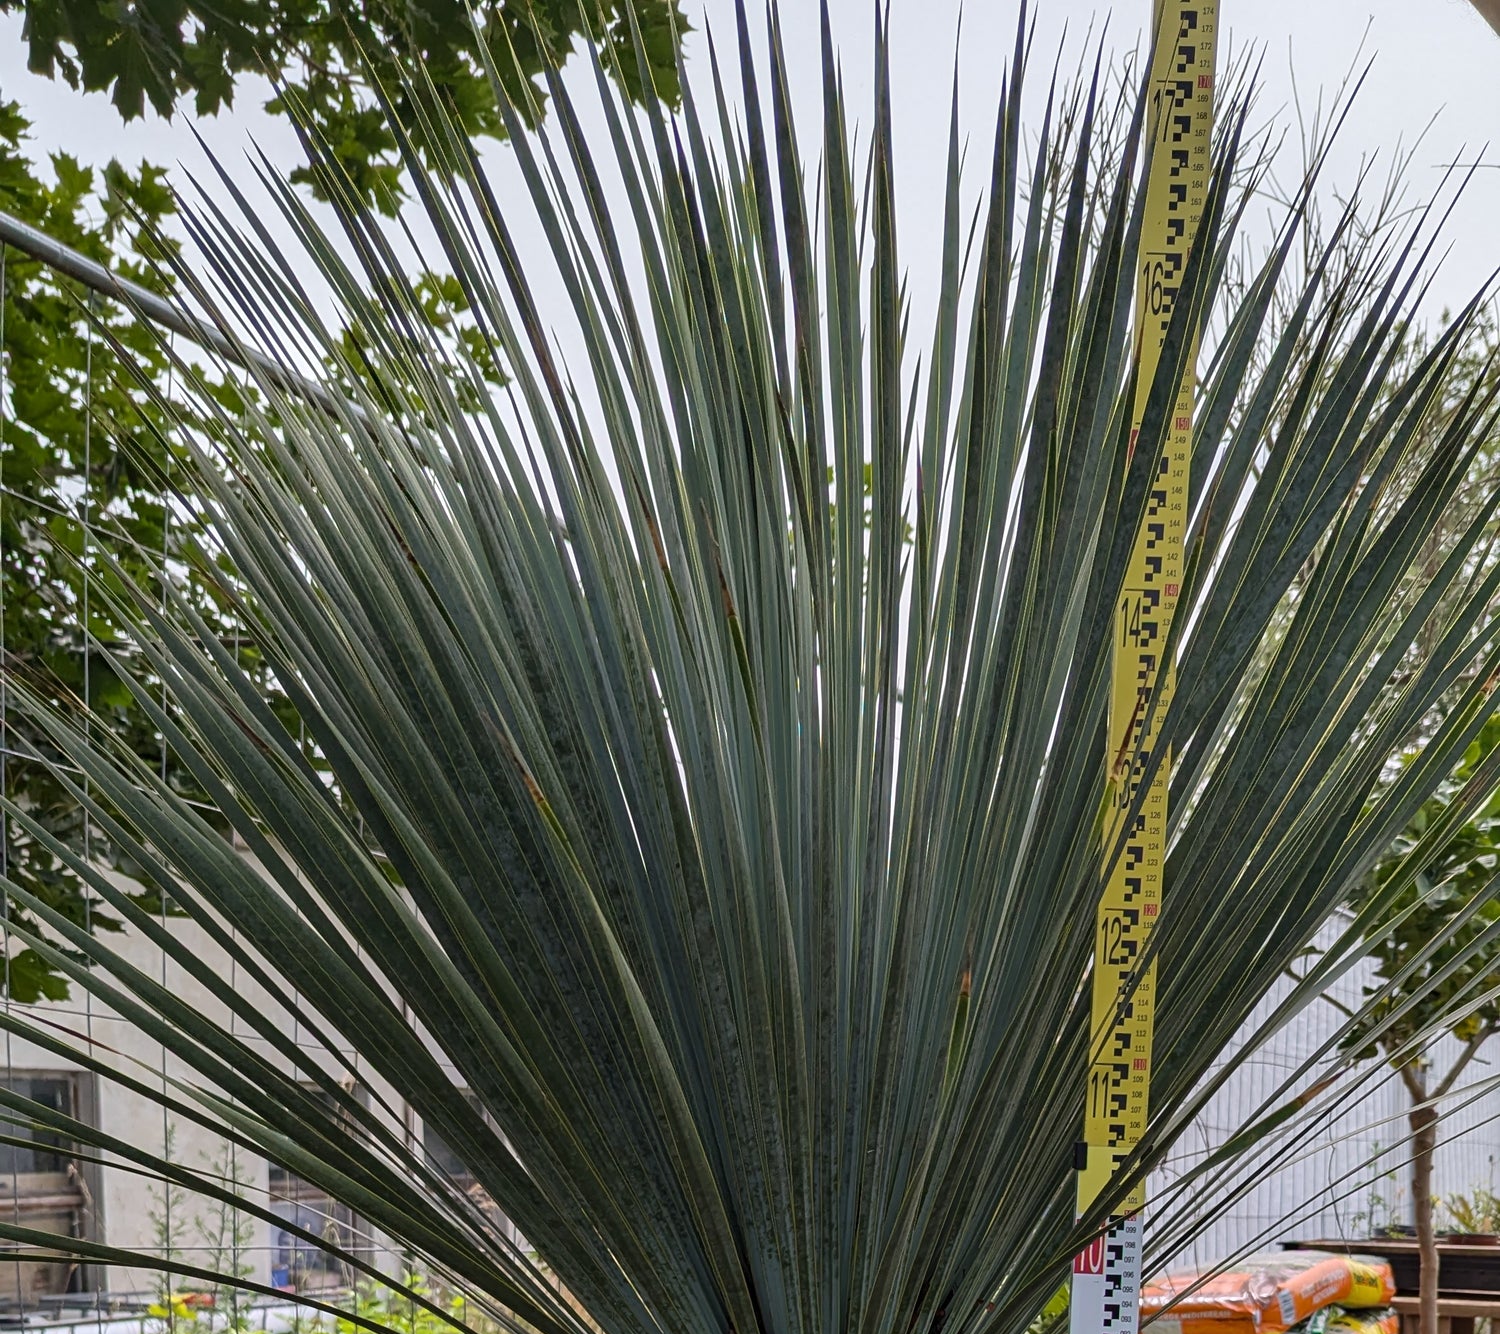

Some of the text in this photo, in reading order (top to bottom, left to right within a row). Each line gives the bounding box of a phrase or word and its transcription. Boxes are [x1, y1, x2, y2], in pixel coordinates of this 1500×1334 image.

[1203, 6, 1215, 14] 174
[1202, 23, 1214, 31] 173
[1200, 41, 1213, 49] 172
[1199, 59, 1212, 67] 171
[1197, 94, 1209, 102] 169
[1154, 89, 1175, 142] 17
[1196, 111, 1208, 119] 168
[1194, 129, 1207, 137] 167
[1193, 146, 1206, 154] 166
[1192, 164, 1205, 172] 165
[1191, 181, 1203, 189] 164
[1143, 261, 1164, 316] 16
[1174, 436, 1186, 444] 149
[1173, 453, 1185, 461] 148
[1172, 470, 1184, 478] 147
[1170, 486, 1183, 494] 146
[1169, 503, 1182, 511] 145
[1168, 519, 1181, 527] 144
[1167, 536, 1180, 544] 143
[1166, 552, 1178, 560] 142
[1165, 569, 1177, 577] 141
[1121, 597, 1141, 648] 14
[1150, 795, 1163, 803] 127
[1148, 826, 1160, 834] 125
[1147, 842, 1159, 850] 124
[1146, 858, 1158, 866] 123
[1144, 889, 1157, 897] 121
[1102, 916, 1122, 965] 12
[1138, 998, 1150, 1006] 114
[1136, 1029, 1148, 1037] 112
[1135, 1044, 1147, 1052] 111
[1132, 1075, 1145, 1083] 109
[1091, 1071, 1109, 1118] 11
[1132, 1090, 1144, 1098] 108
[1131, 1105, 1143, 1113] 107
[1126, 1196, 1138, 1204] 101
[1125, 1226, 1137, 1234] 099
[1124, 1241, 1136, 1249] 098
[1123, 1256, 1135, 1264] 097
[1120, 1315, 1132, 1323] 093
